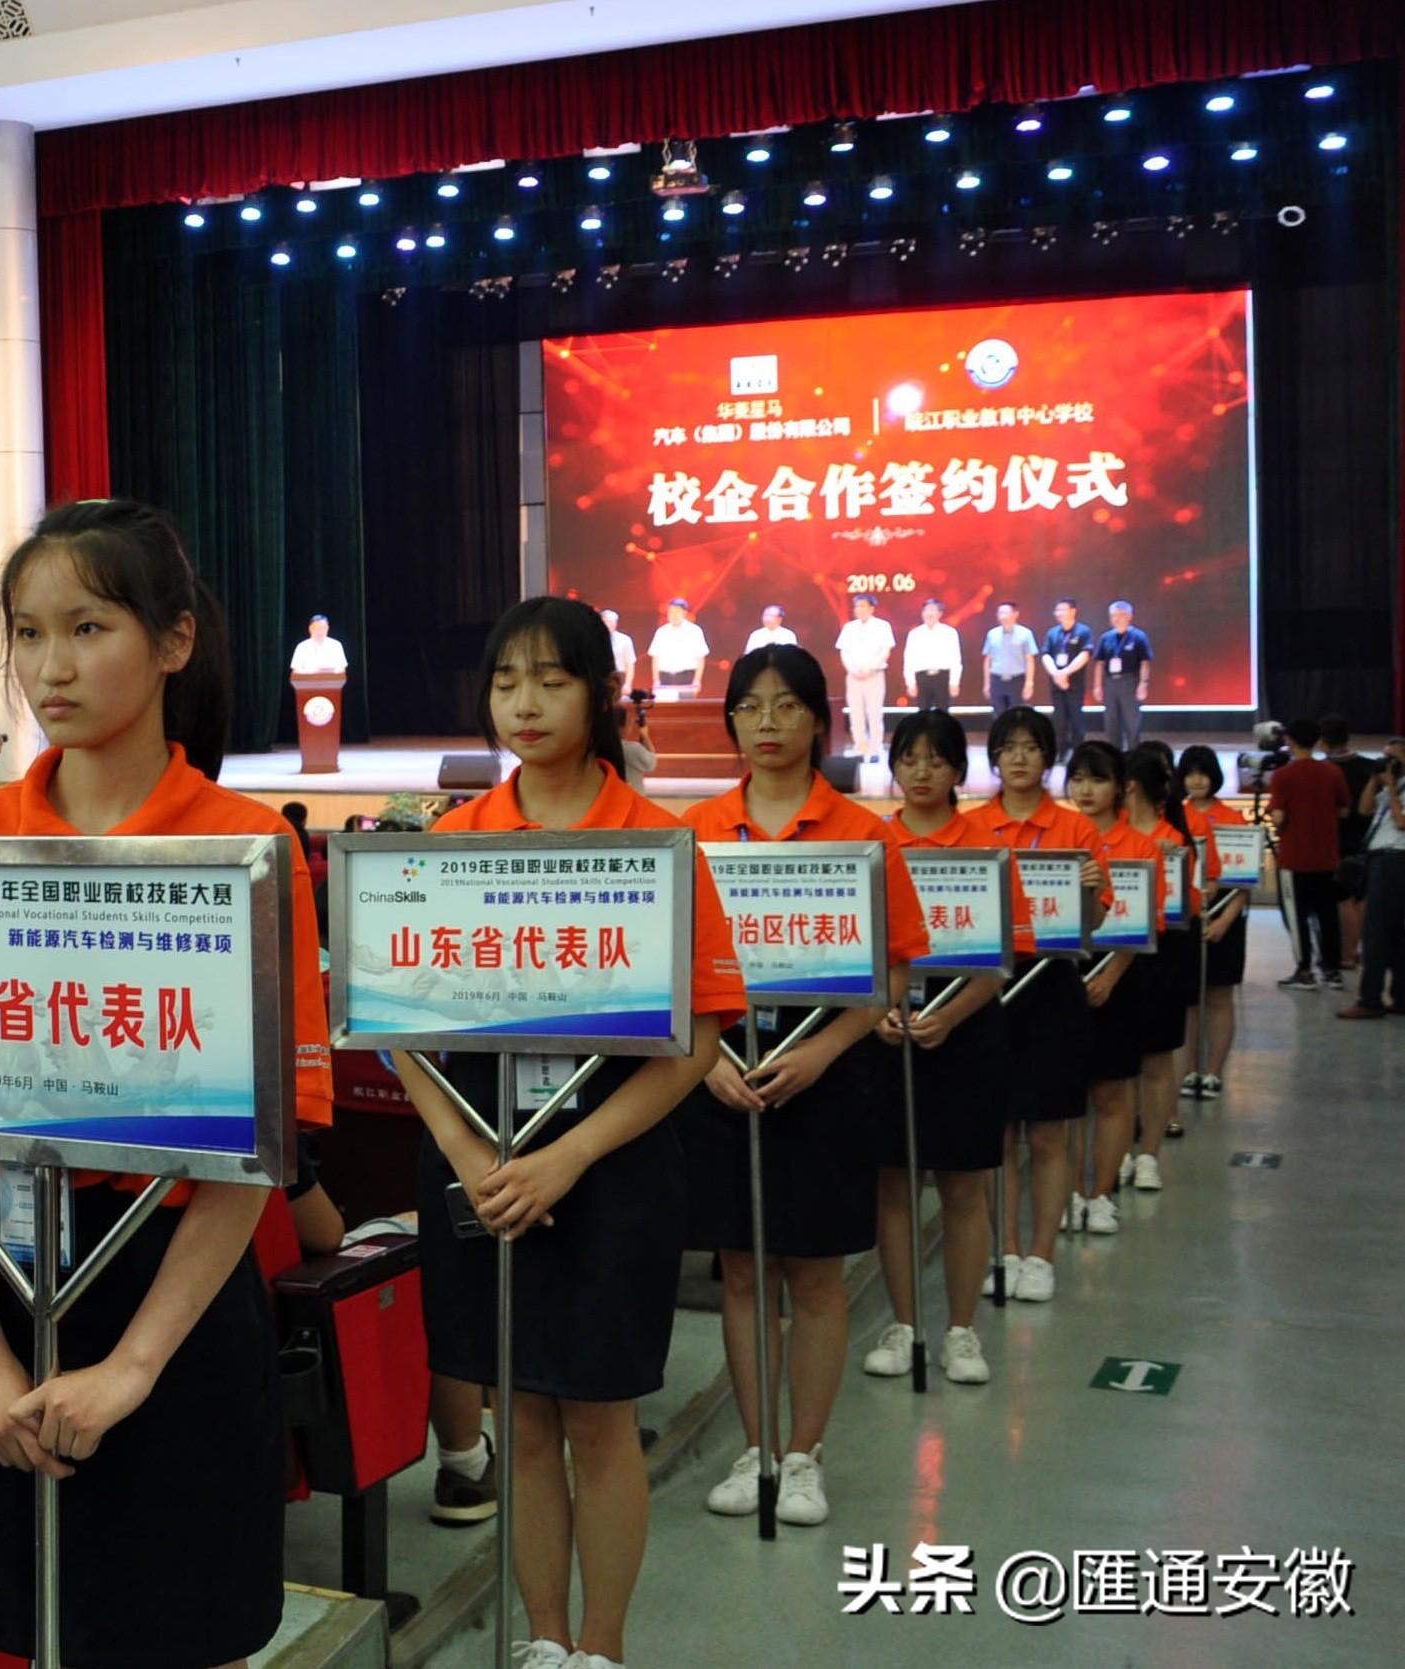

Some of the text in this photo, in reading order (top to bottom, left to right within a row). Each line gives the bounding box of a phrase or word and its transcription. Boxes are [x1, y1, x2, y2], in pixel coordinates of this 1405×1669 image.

[648, 451, 1128, 528] 校企合作签约仪式
[847, 573, 916, 594] 2019.06
[440, 858, 657, 875] 2019年全国职业院校技能大赛
[358, 890, 427, 904] ChinaSkills
[483, 890, 656, 905] 新能源汽车检测与维修赛项
[23, 908, 79, 920] Vocational
[82, 909, 129, 922] Students
[132, 910, 161, 922] Skills
[164, 911, 233, 925] Competition
[8, 928, 233, 954] 新能源汽车检测与维修赛项
[391, 926, 631, 970] 山东省代表队
